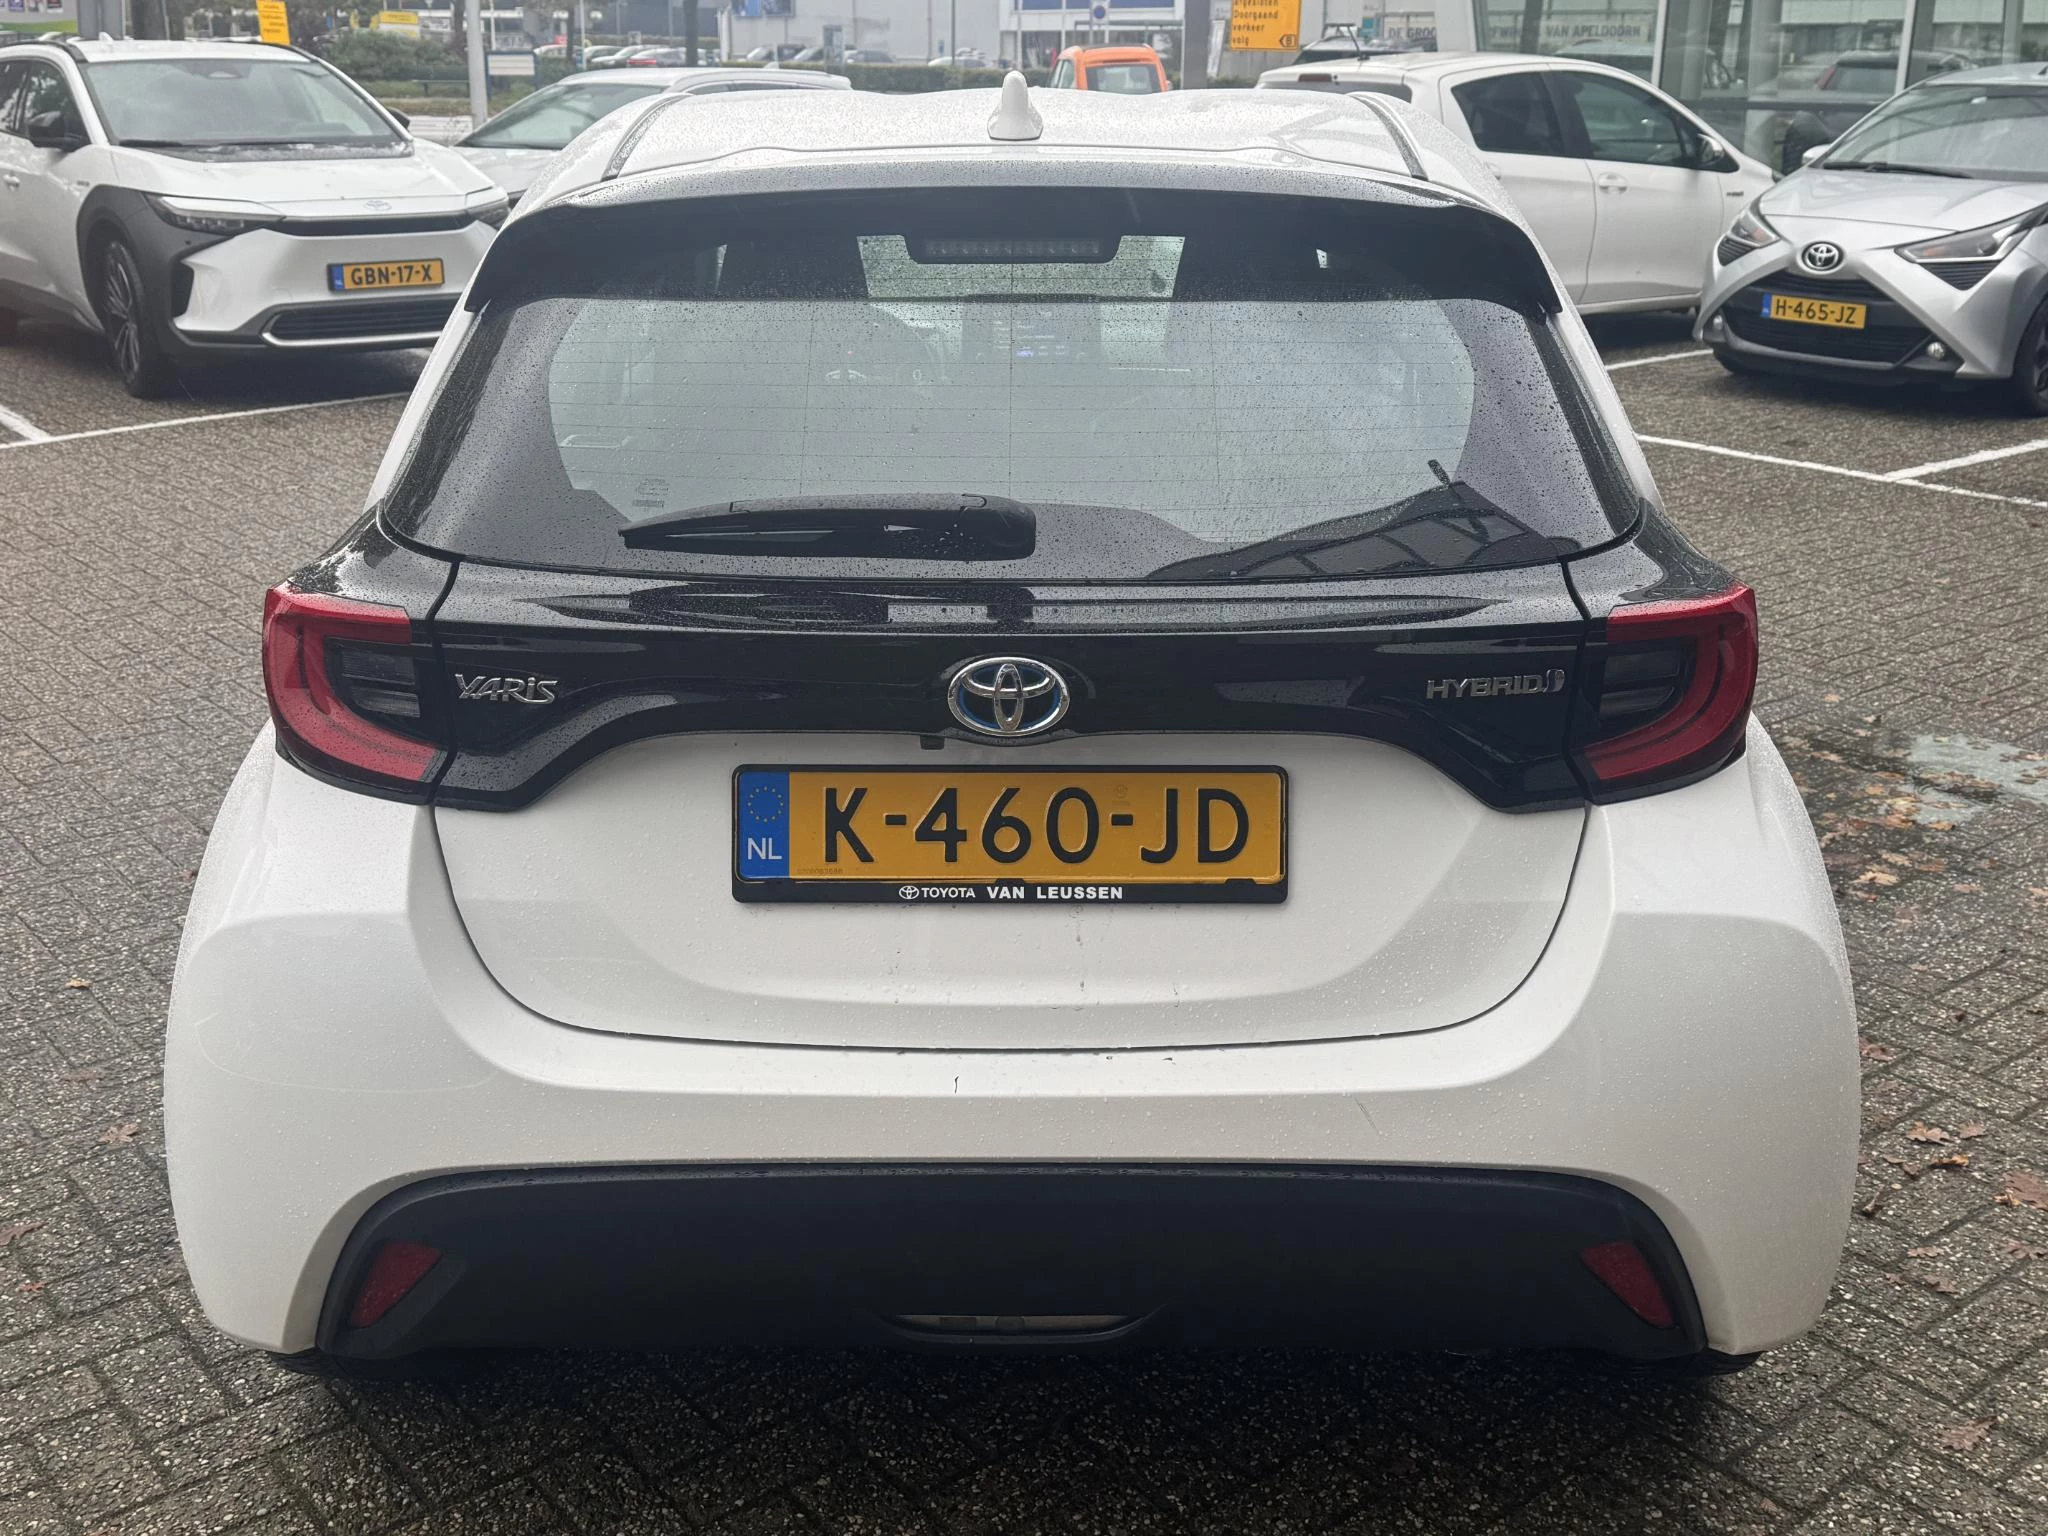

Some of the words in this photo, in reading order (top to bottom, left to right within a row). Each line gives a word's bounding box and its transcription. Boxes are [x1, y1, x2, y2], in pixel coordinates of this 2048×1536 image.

[1234, 10, 1279, 21] Doorgaand
[1233, 23, 1265, 32] verkeer
[1546, 25, 1569, 37] VAN
[1572, 24, 1641, 37] APELDOORN
[1232, 36, 1250, 46] volg
[350, 264, 433, 286] GBN-17-X
[1775, 299, 1857, 325] H-465-JZ
[1426, 674, 1543, 699] HYBRID
[822, 786, 1250, 864] K-460-JD
[747, 837, 782, 860] NL
[921, 886, 976, 899] TOYOTA
[986, 885, 1025, 899] VAN
[1036, 885, 1123, 899] LEUSSEN
